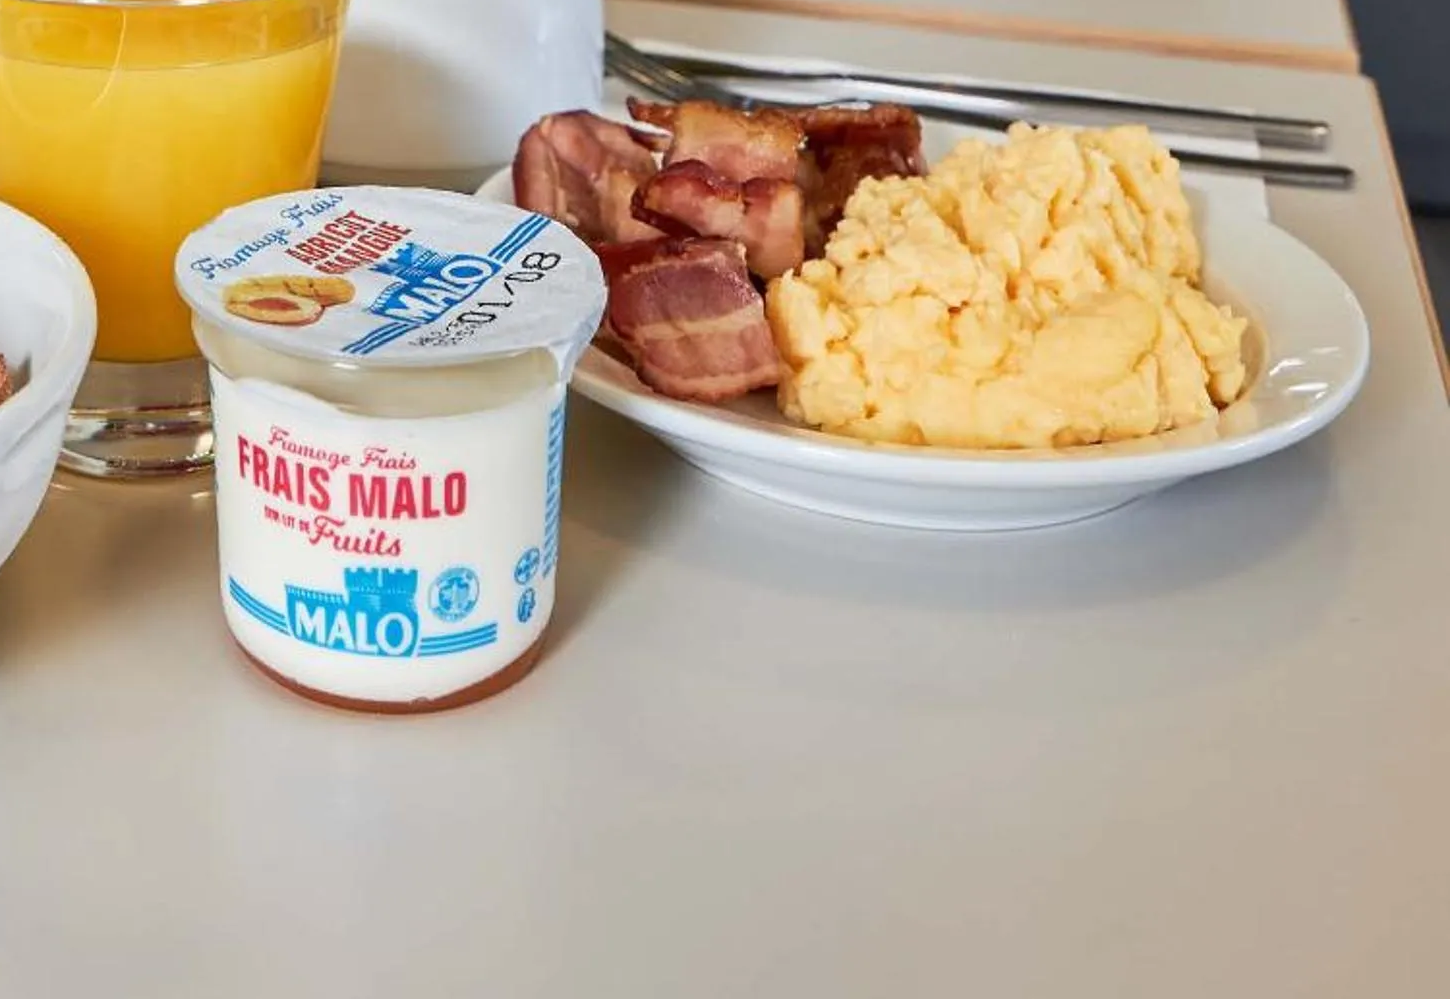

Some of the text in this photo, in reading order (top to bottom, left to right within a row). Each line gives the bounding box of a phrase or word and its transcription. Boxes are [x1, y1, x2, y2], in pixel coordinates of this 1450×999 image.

[284, 210, 376, 265] ABRICOT
[314, 221, 412, 274] MANGUE
[384, 257, 493, 325] MALO
[456, 252, 562, 324] 01/08
[267, 425, 417, 470] Fromage Frais
[237, 434, 468, 519] FRAIS MALO
[309, 515, 402, 557] Fruits
[295, 602, 413, 655] MALO
